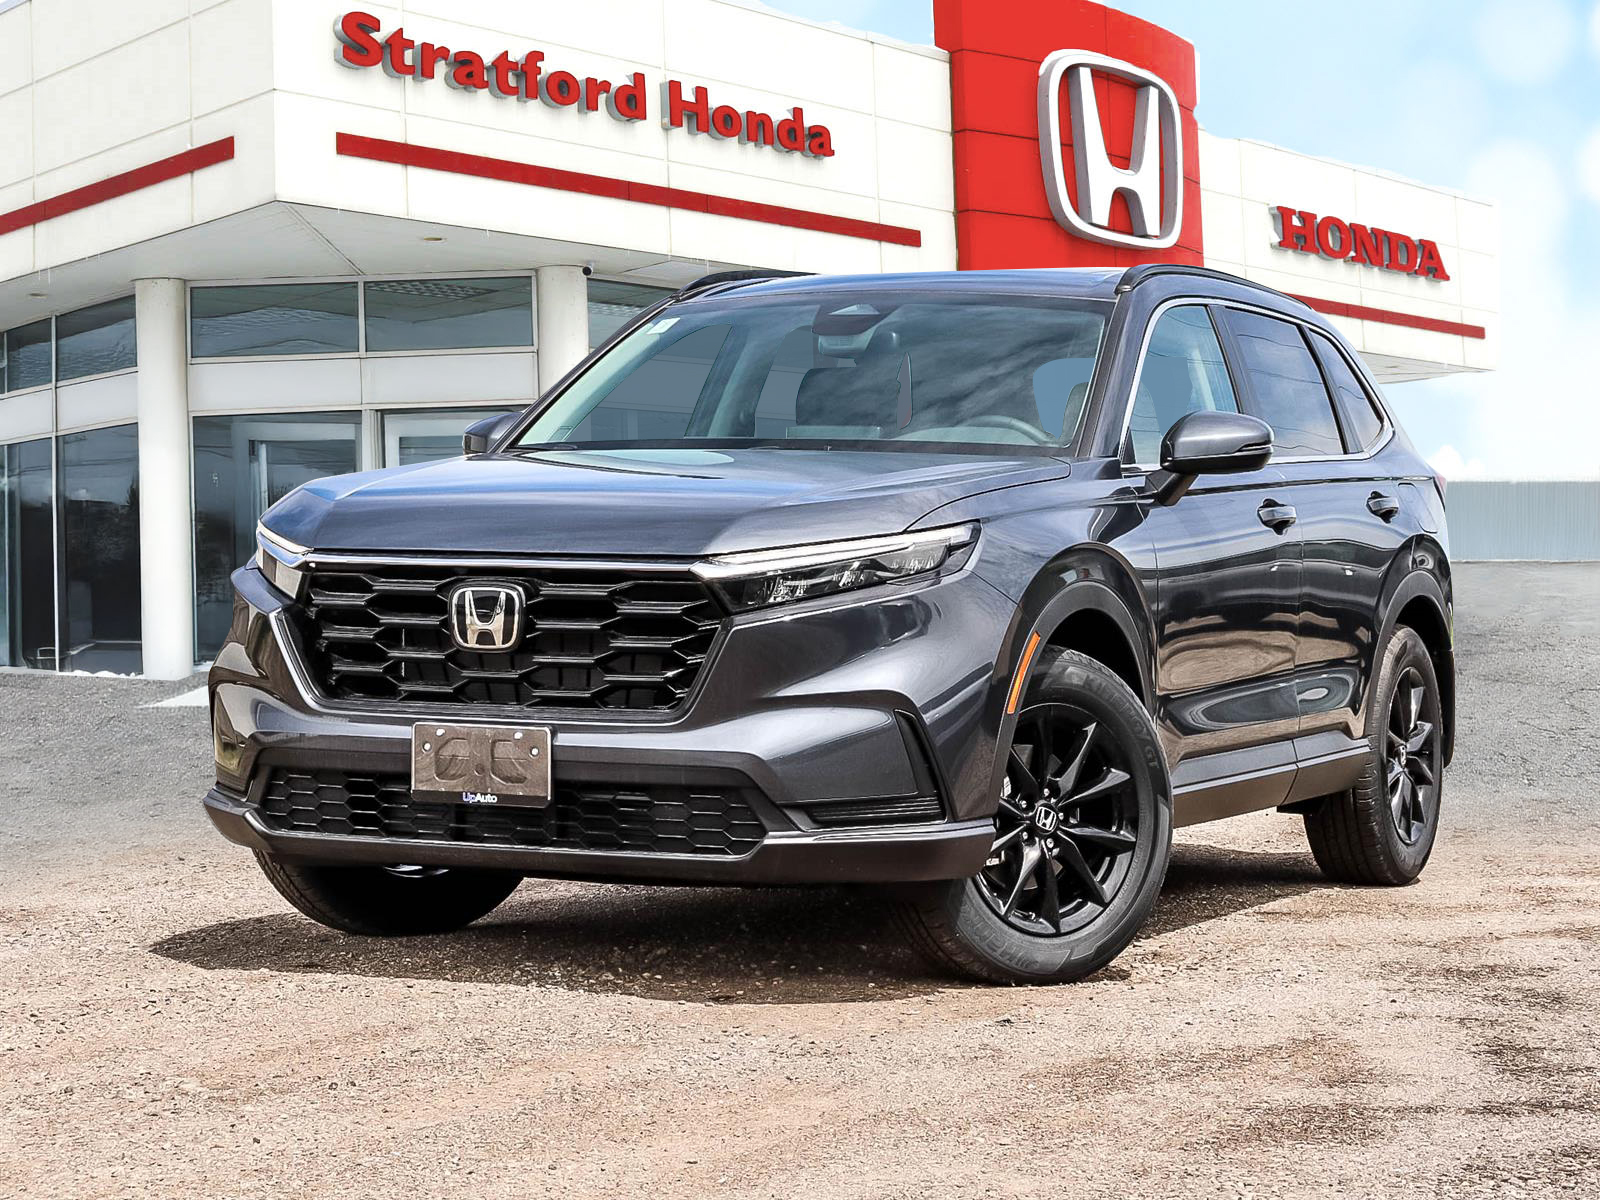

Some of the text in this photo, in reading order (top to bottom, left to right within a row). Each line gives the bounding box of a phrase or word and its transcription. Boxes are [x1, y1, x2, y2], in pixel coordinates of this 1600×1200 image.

[336, 11, 835, 159] Stratford Honda
[1270, 205, 1450, 282] HONDA
[462, 792, 498, 804] UpAuto
